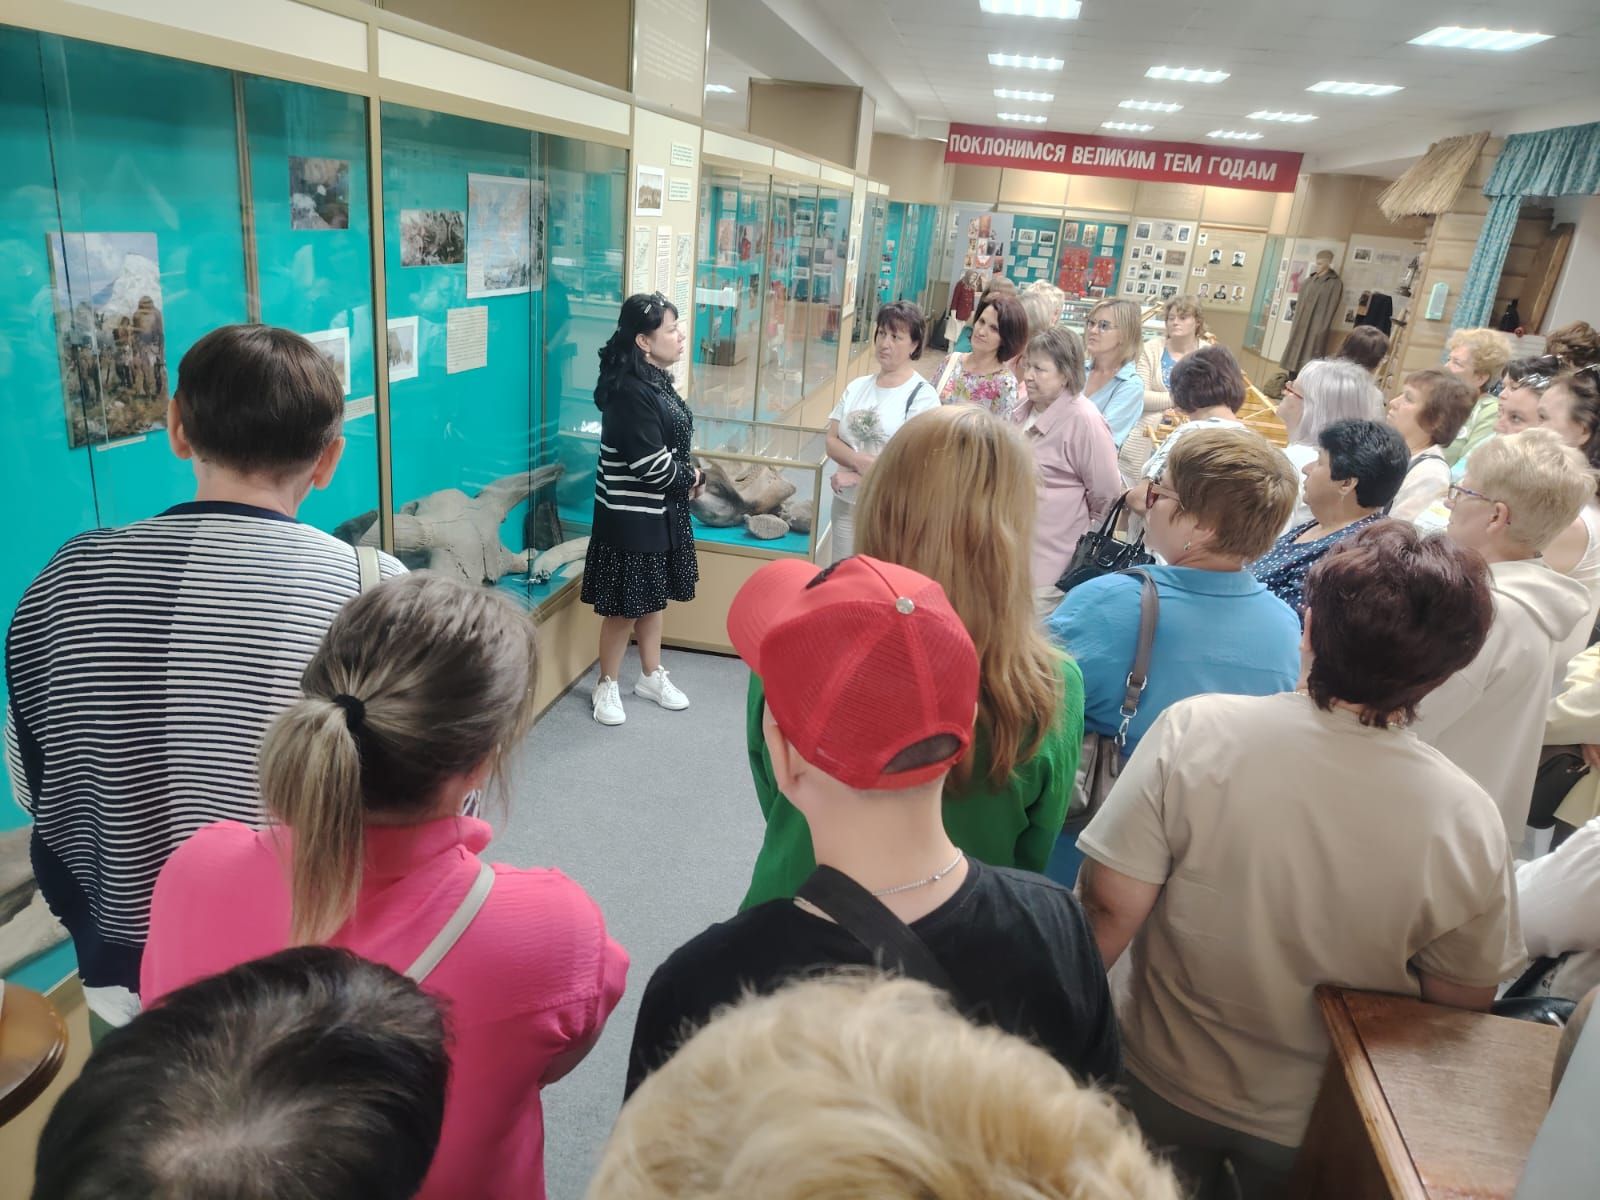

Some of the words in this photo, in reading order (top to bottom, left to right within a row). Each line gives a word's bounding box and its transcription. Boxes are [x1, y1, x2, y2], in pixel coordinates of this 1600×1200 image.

[949, 133, 1067, 162] ПОКЛОНИМСЯ
[1071, 146, 1156, 170] ВЕЛИКИМ
[1163, 153, 1203, 174] ТЕМ
[1207, 156, 1278, 181] ГОДАМ
